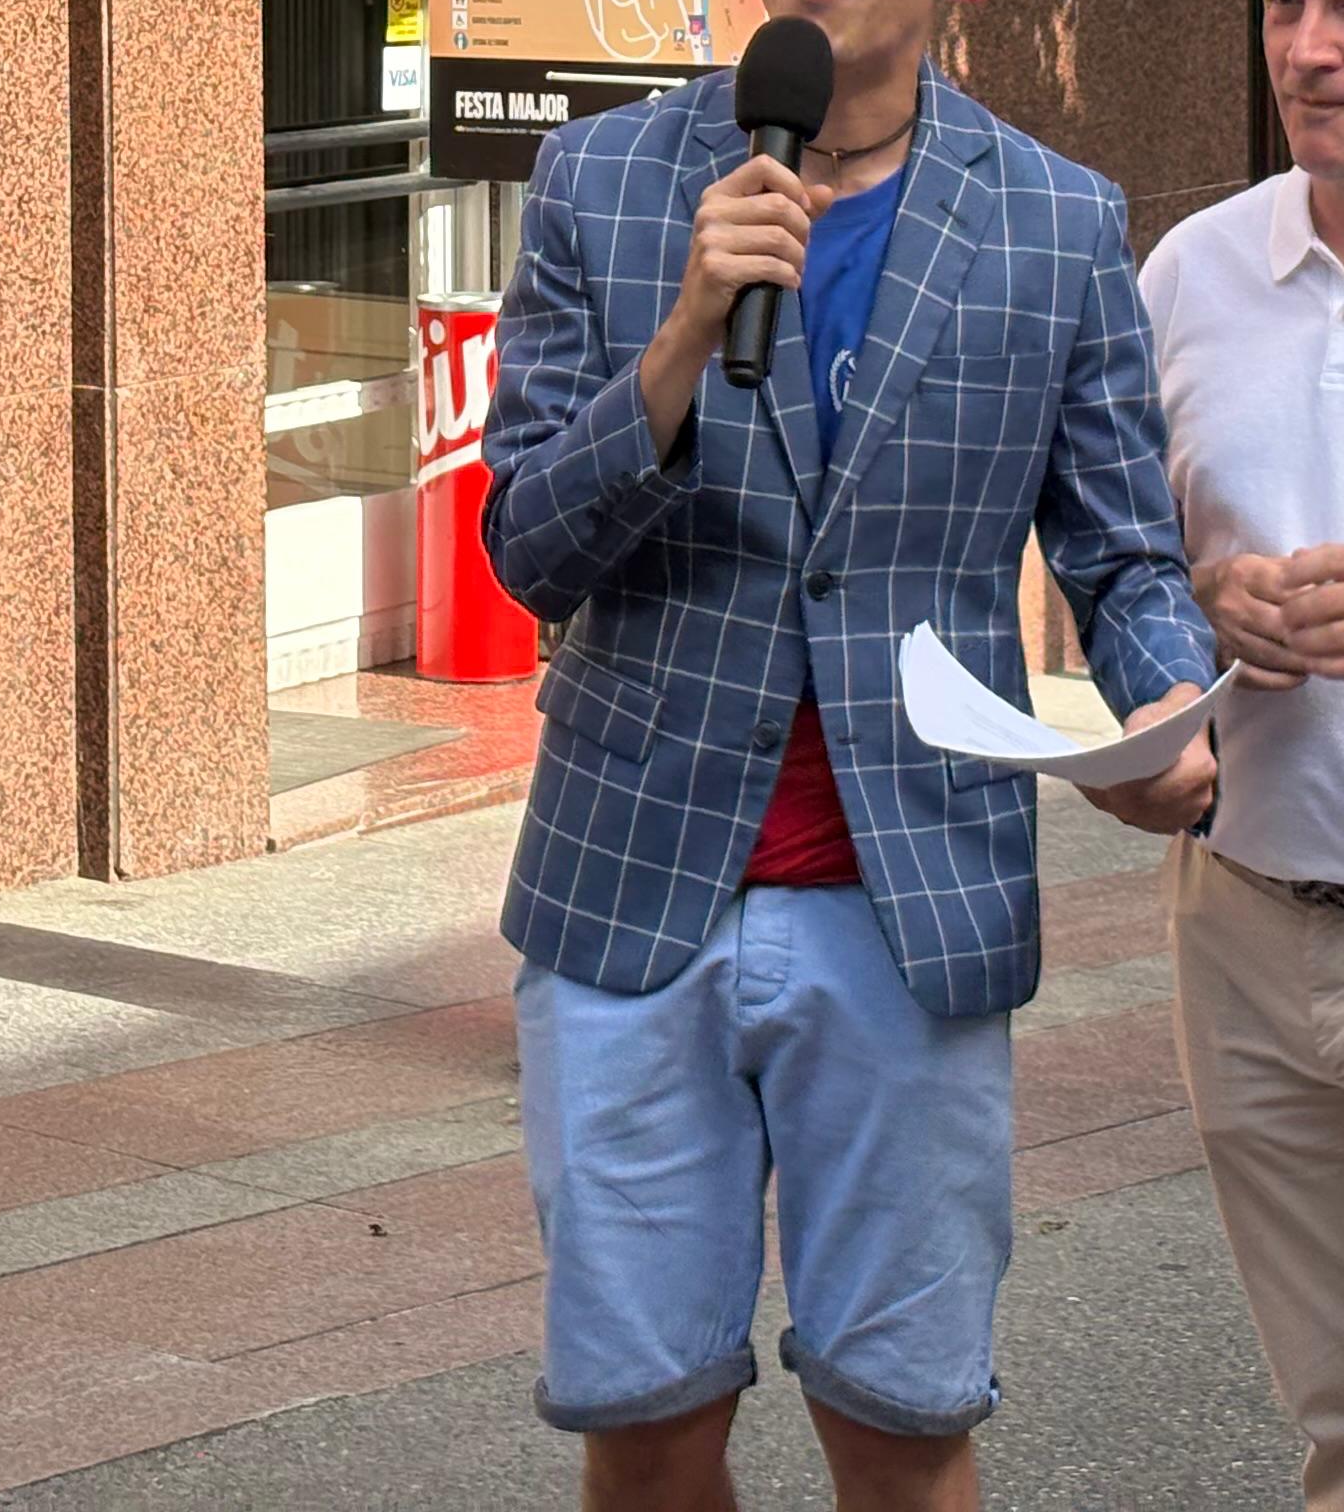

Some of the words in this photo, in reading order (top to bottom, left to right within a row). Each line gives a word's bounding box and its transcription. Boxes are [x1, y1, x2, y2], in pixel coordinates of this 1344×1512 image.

[389, 69, 417, 86] VISA
[456, 90, 505, 120] FESTA
[508, 92, 569, 122] MAJOR
